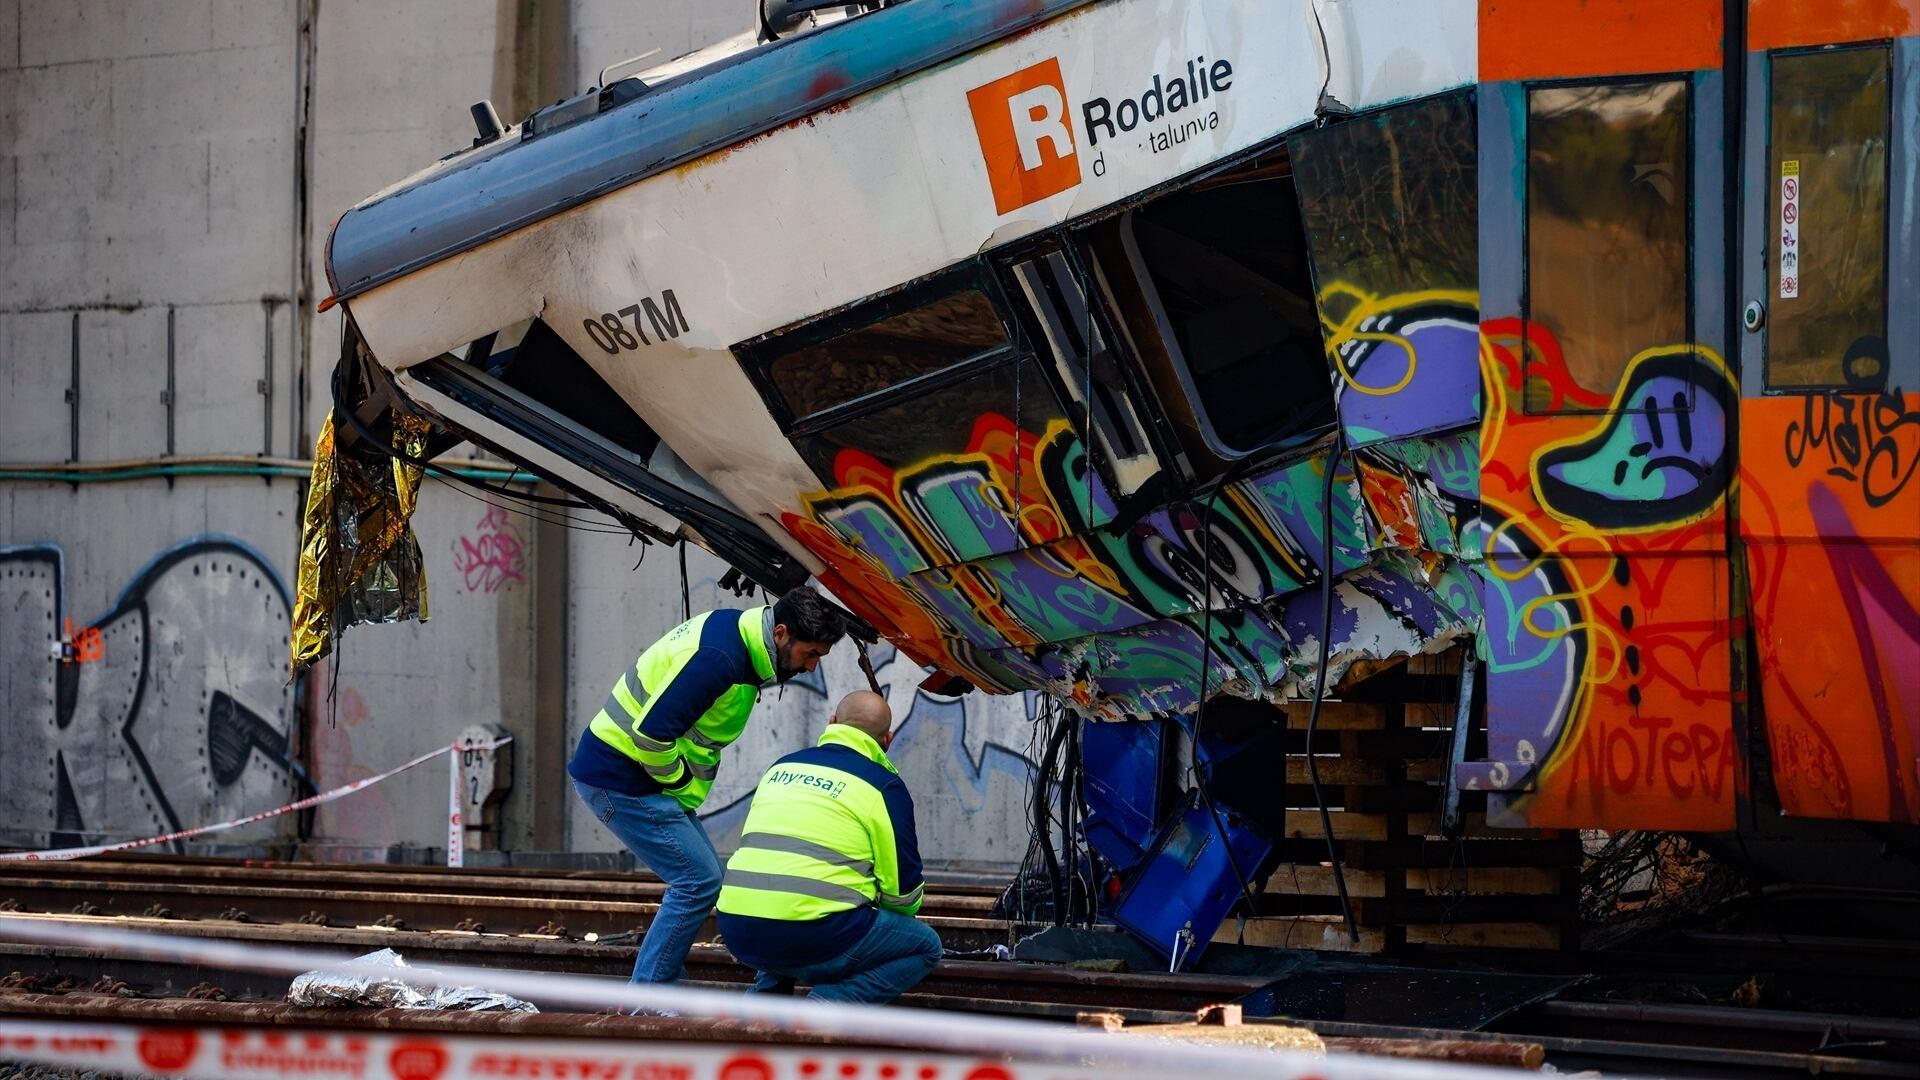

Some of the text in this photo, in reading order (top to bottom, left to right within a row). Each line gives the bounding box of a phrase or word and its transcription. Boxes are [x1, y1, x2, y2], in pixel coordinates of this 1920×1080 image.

[583, 288, 690, 355] 087M
[470, 776, 479, 805] 2
[766, 770, 834, 791] Ahyresa
